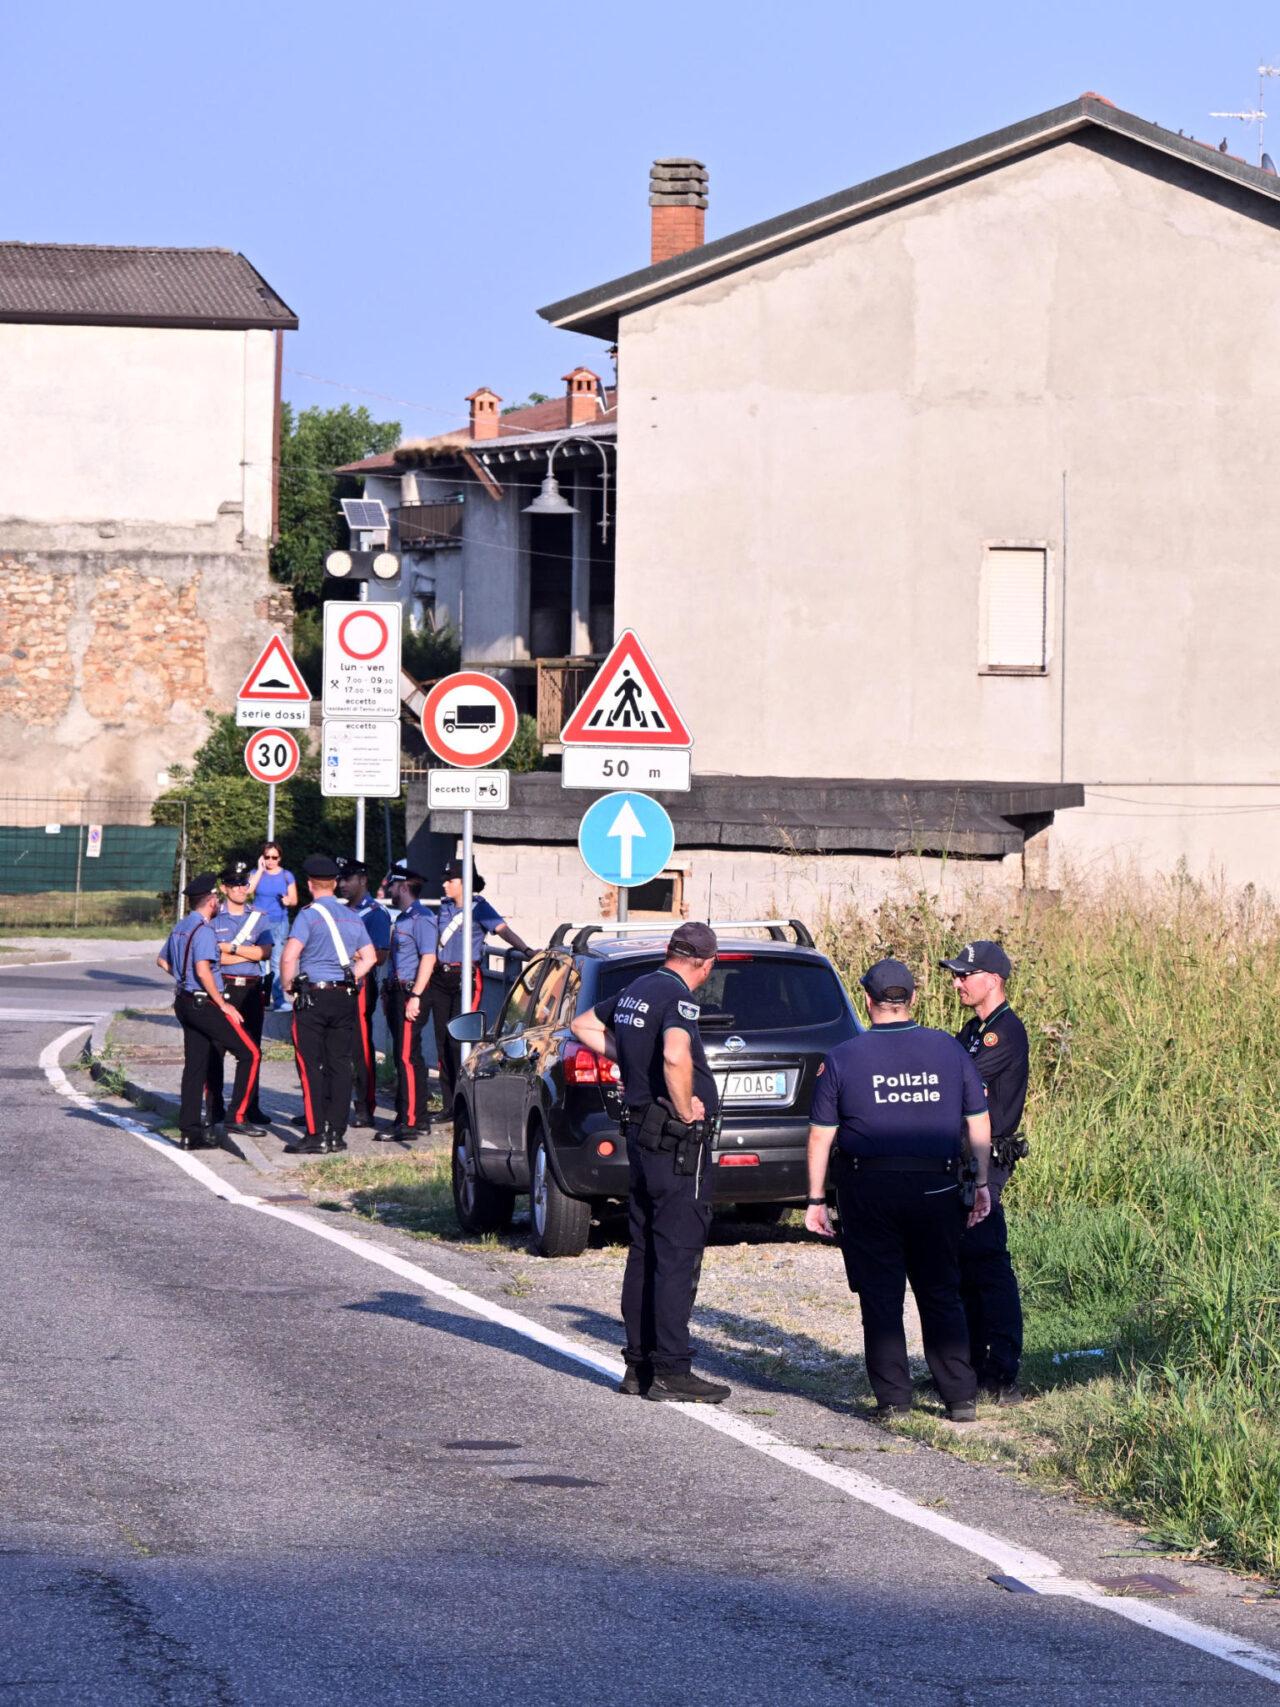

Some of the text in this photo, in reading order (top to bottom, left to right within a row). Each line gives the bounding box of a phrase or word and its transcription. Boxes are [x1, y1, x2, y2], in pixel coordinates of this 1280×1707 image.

[340, 663, 357, 671] lun
[242, 708, 306, 720] serie dossi
[258, 743, 288, 768] 30
[602, 759, 661, 778] 50 m
[434, 784, 471, 794] eccetto
[617, 996, 650, 1014] olizia
[613, 1012, 645, 1028] ocale
[872, 1071, 940, 1089] Polizia
[874, 1088, 941, 1104] Locale
